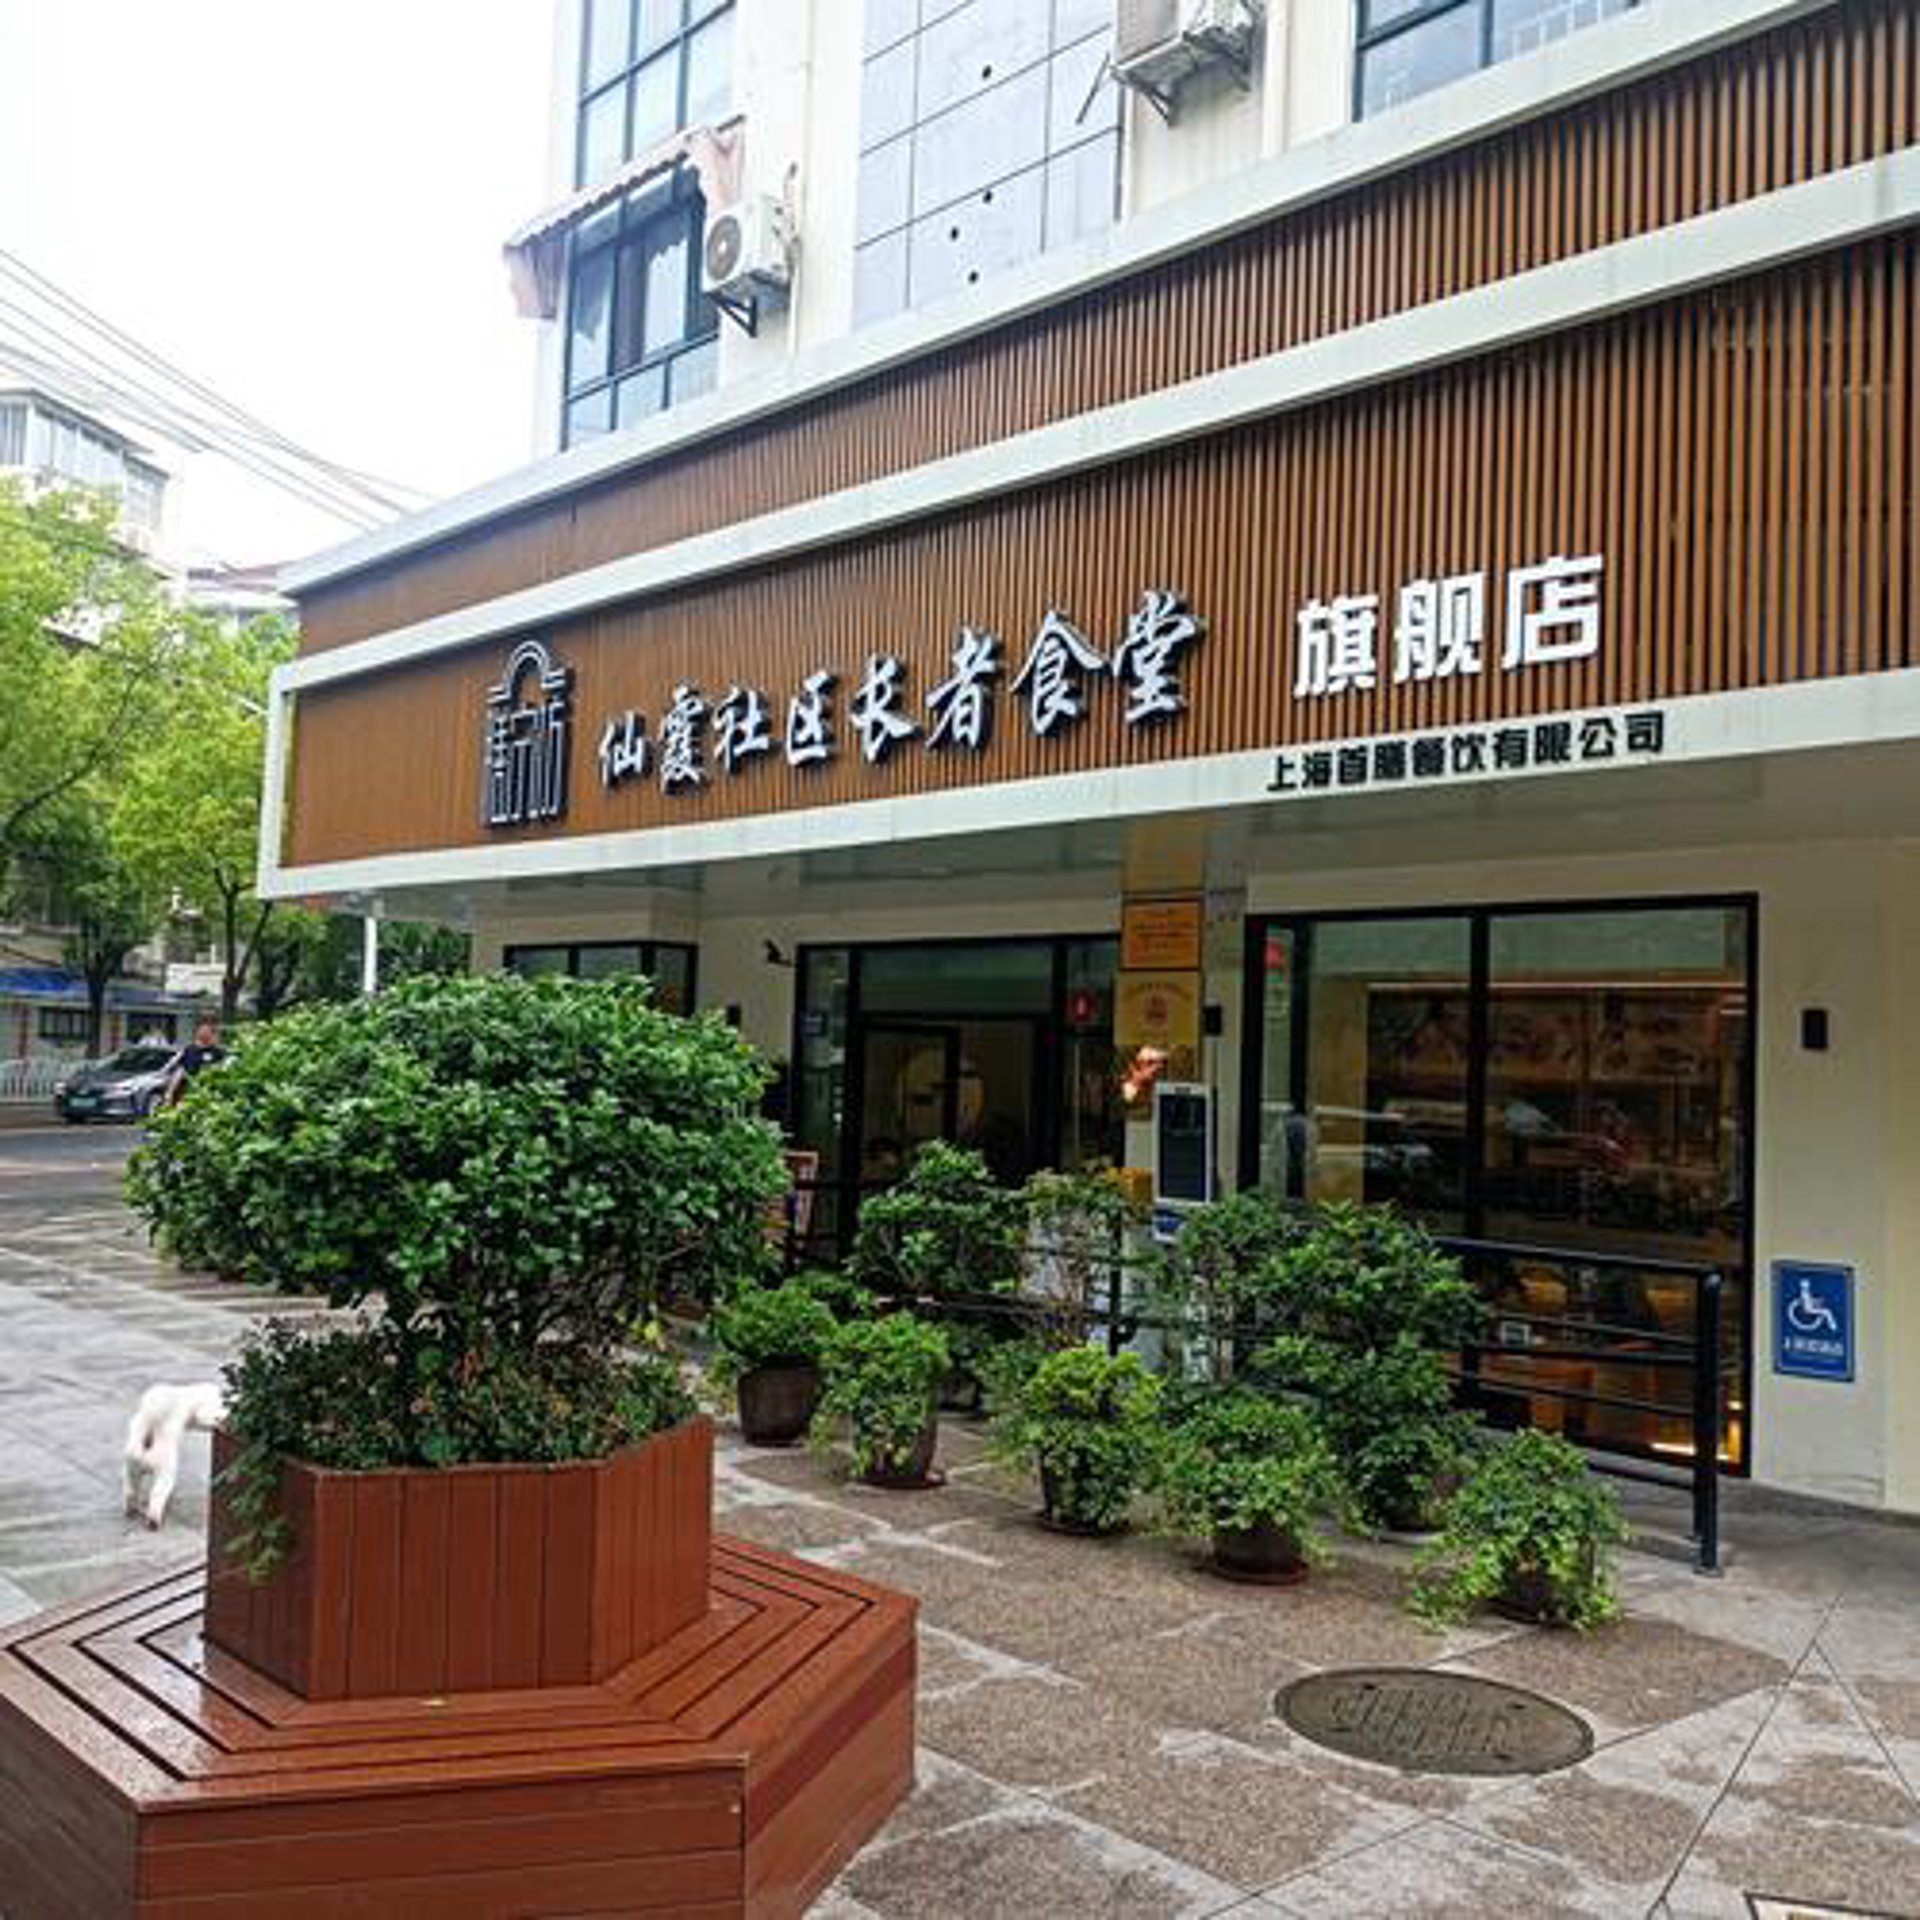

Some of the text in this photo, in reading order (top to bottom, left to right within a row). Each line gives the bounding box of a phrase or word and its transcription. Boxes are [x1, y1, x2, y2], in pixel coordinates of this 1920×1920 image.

[599, 591, 1203, 796] 仙霞社区长者食堂
[1294, 554, 1603, 698] 旗舰店
